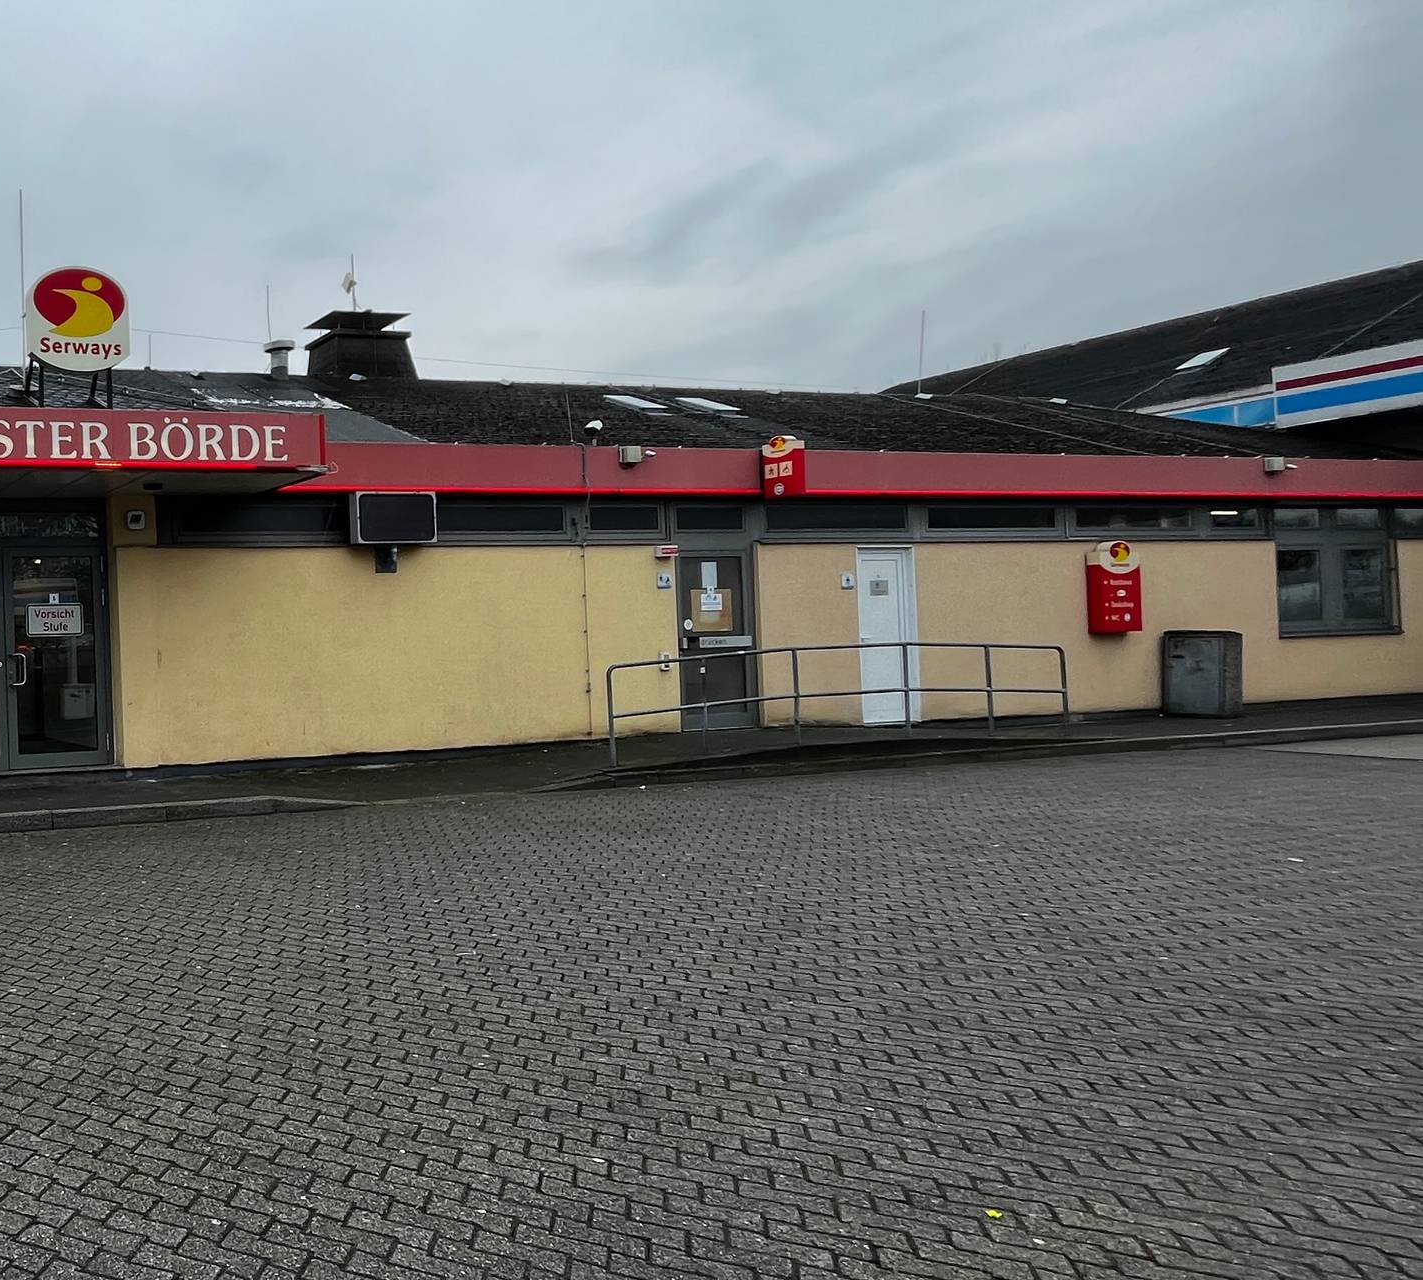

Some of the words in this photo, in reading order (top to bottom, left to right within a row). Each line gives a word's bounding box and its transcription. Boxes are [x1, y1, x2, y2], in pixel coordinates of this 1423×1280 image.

[40, 337, 122, 359] Serways
[128, 416, 288, 462] BÖRDE
[34, 609, 75, 619] Vorsicht
[43, 621, 69, 632] Stufe
